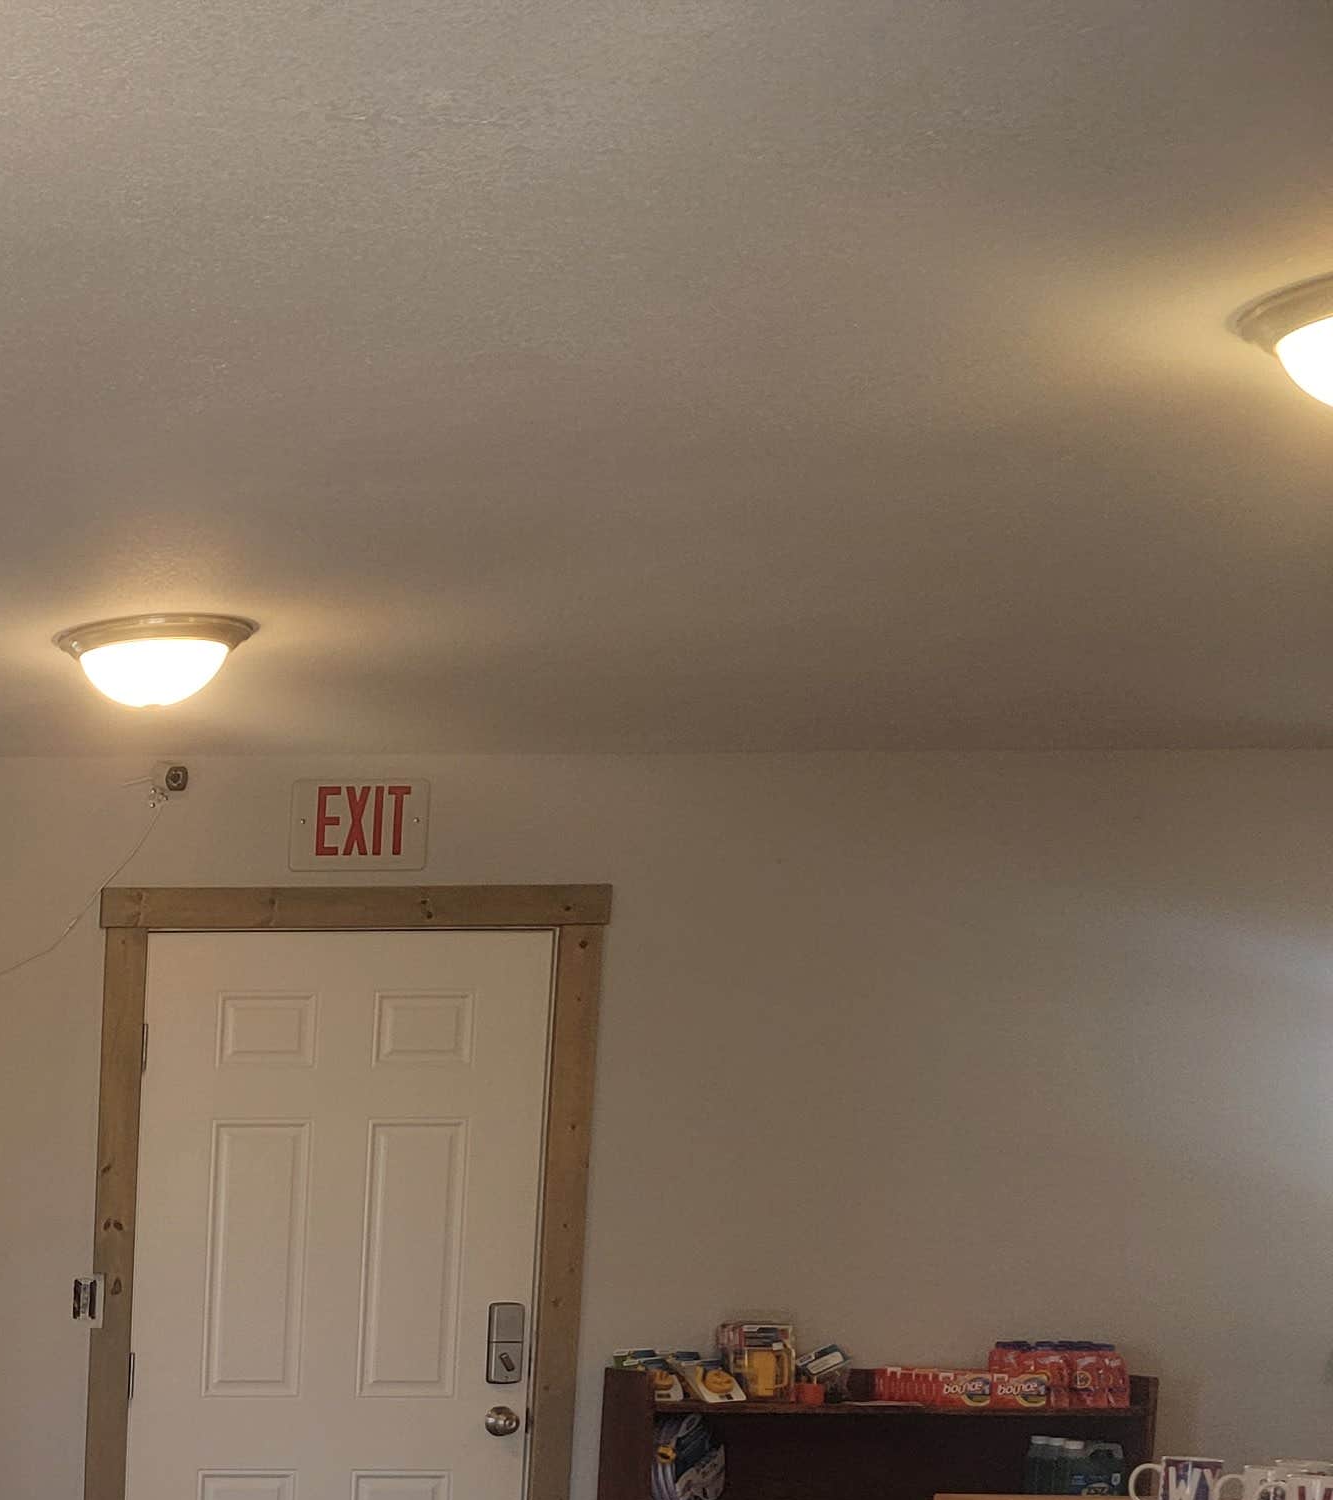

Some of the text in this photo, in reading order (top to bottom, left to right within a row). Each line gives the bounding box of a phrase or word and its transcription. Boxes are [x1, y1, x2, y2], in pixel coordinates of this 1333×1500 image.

[315, 785, 412, 856] EXIT
[943, 1379, 983, 1395] bounce
[997, 1379, 1038, 1395] bounce
